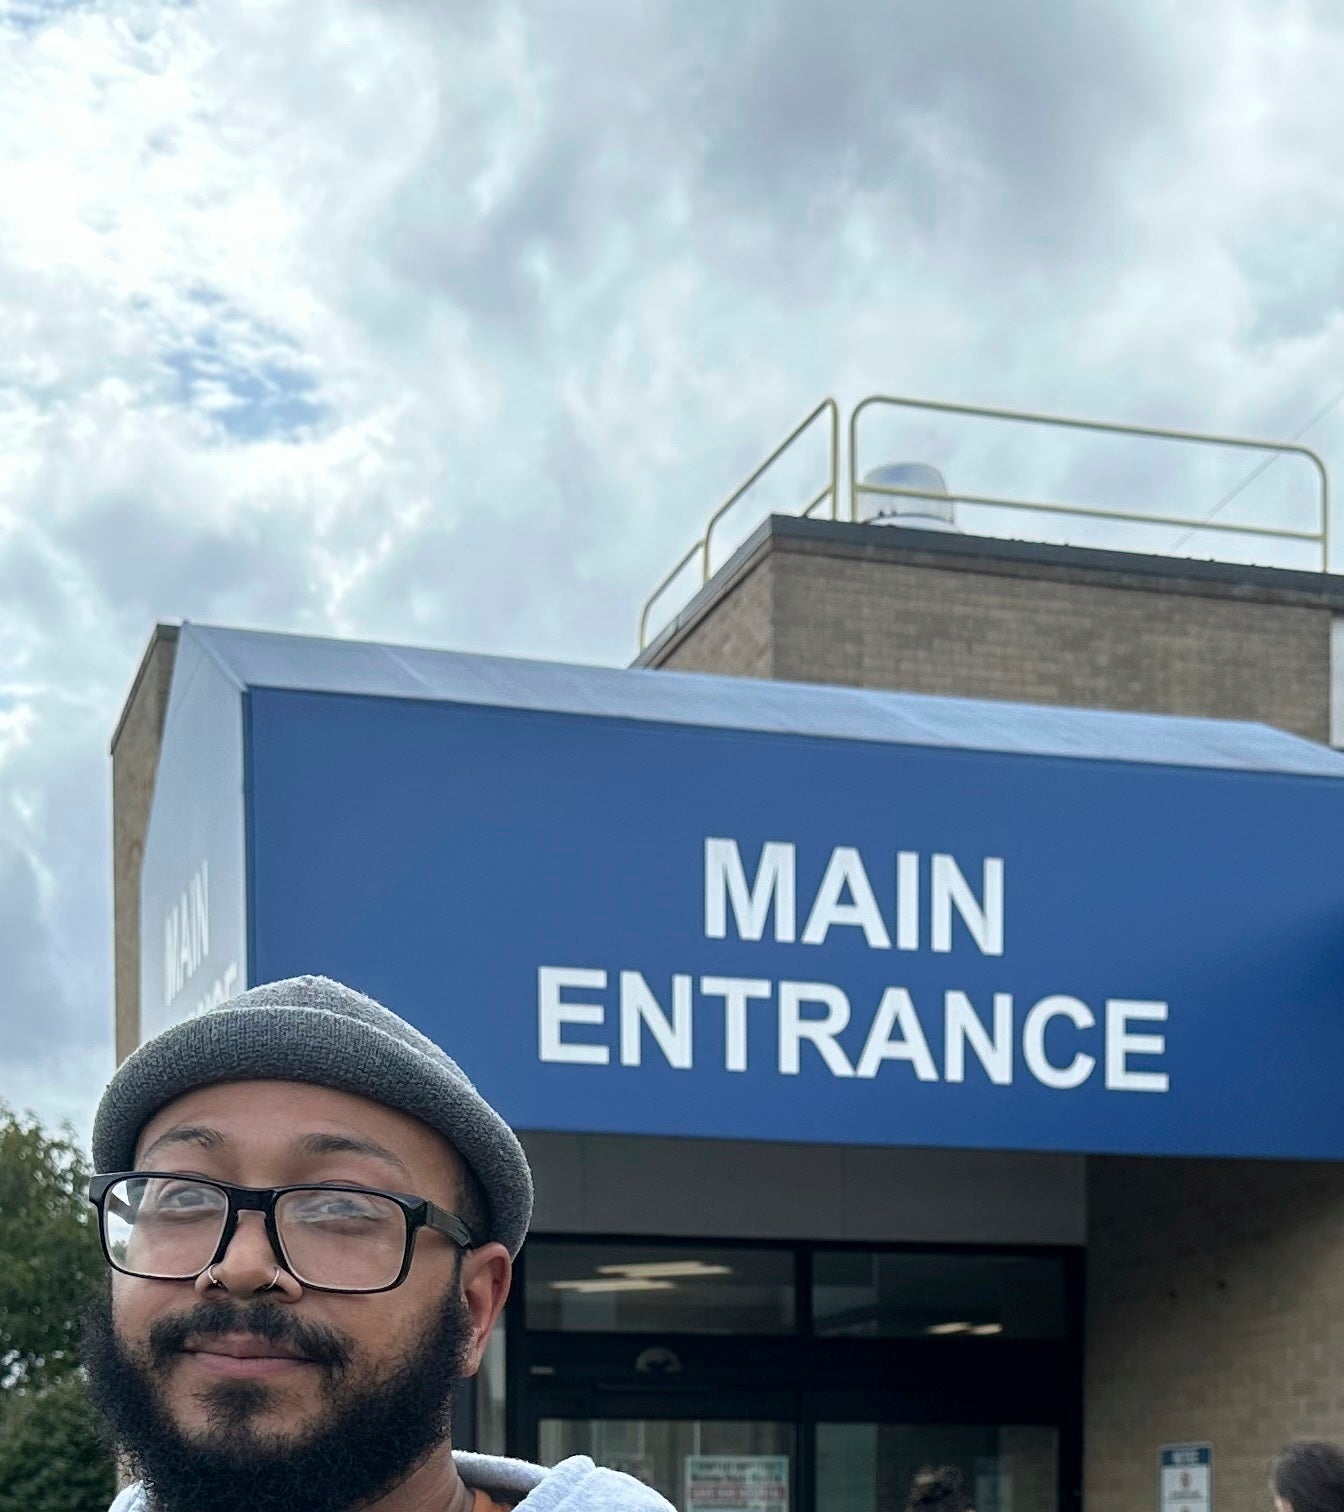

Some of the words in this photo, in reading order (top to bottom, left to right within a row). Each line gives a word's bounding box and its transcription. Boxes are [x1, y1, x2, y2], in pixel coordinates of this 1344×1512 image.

[164, 859, 209, 1007] MAIN
[704, 836, 1005, 956] MAIN
[537, 965, 1170, 1093] ENTRANCE
